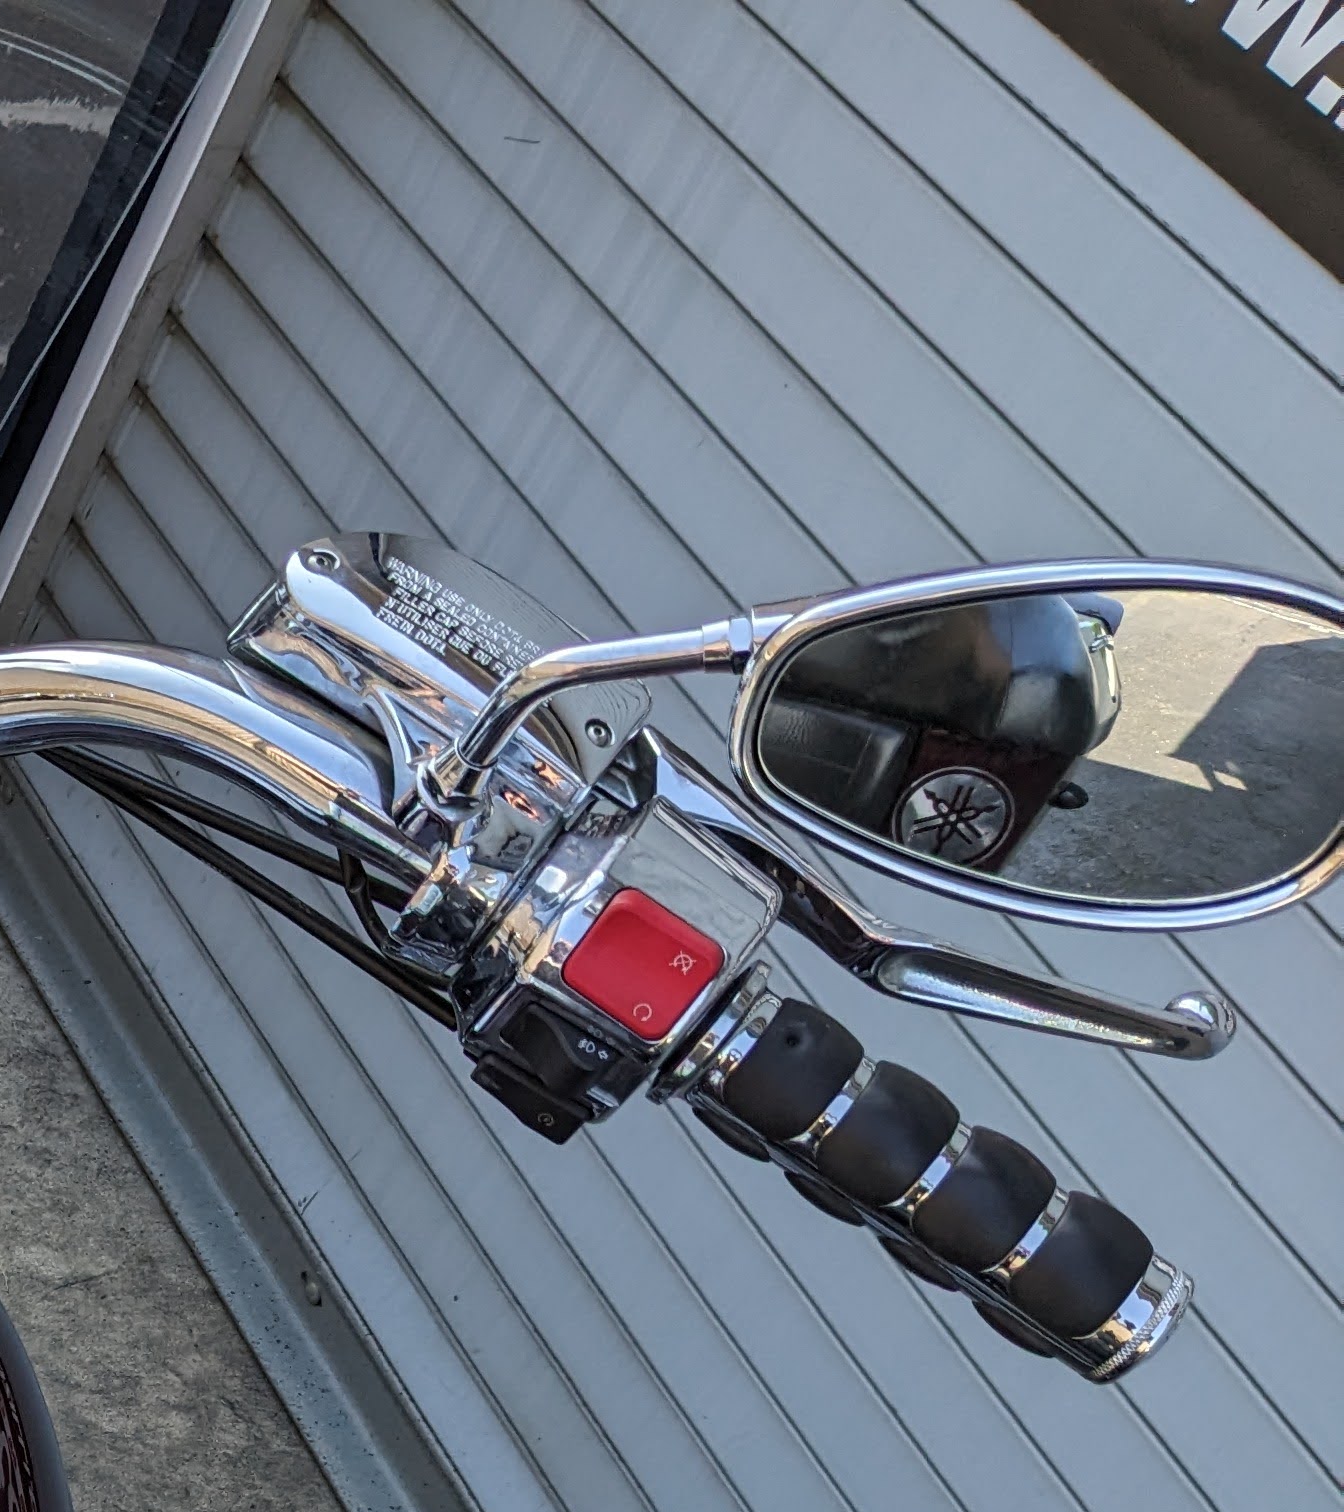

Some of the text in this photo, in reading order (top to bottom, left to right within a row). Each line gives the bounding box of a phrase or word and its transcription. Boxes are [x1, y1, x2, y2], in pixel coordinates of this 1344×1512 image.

[387, 557, 442, 593] WARNING
[442, 589, 465, 606] USE
[465, 604, 494, 622] ONLY
[387, 572, 422, 595] FROM
[424, 592, 433, 602] A
[434, 597, 476, 626] SEALED
[393, 587, 436, 617] FILLER
[435, 611, 459, 629] CAP
[376, 606, 415, 635] FREIN
[448, 635, 474, 655] QUE
[473, 649, 492, 666] DU
